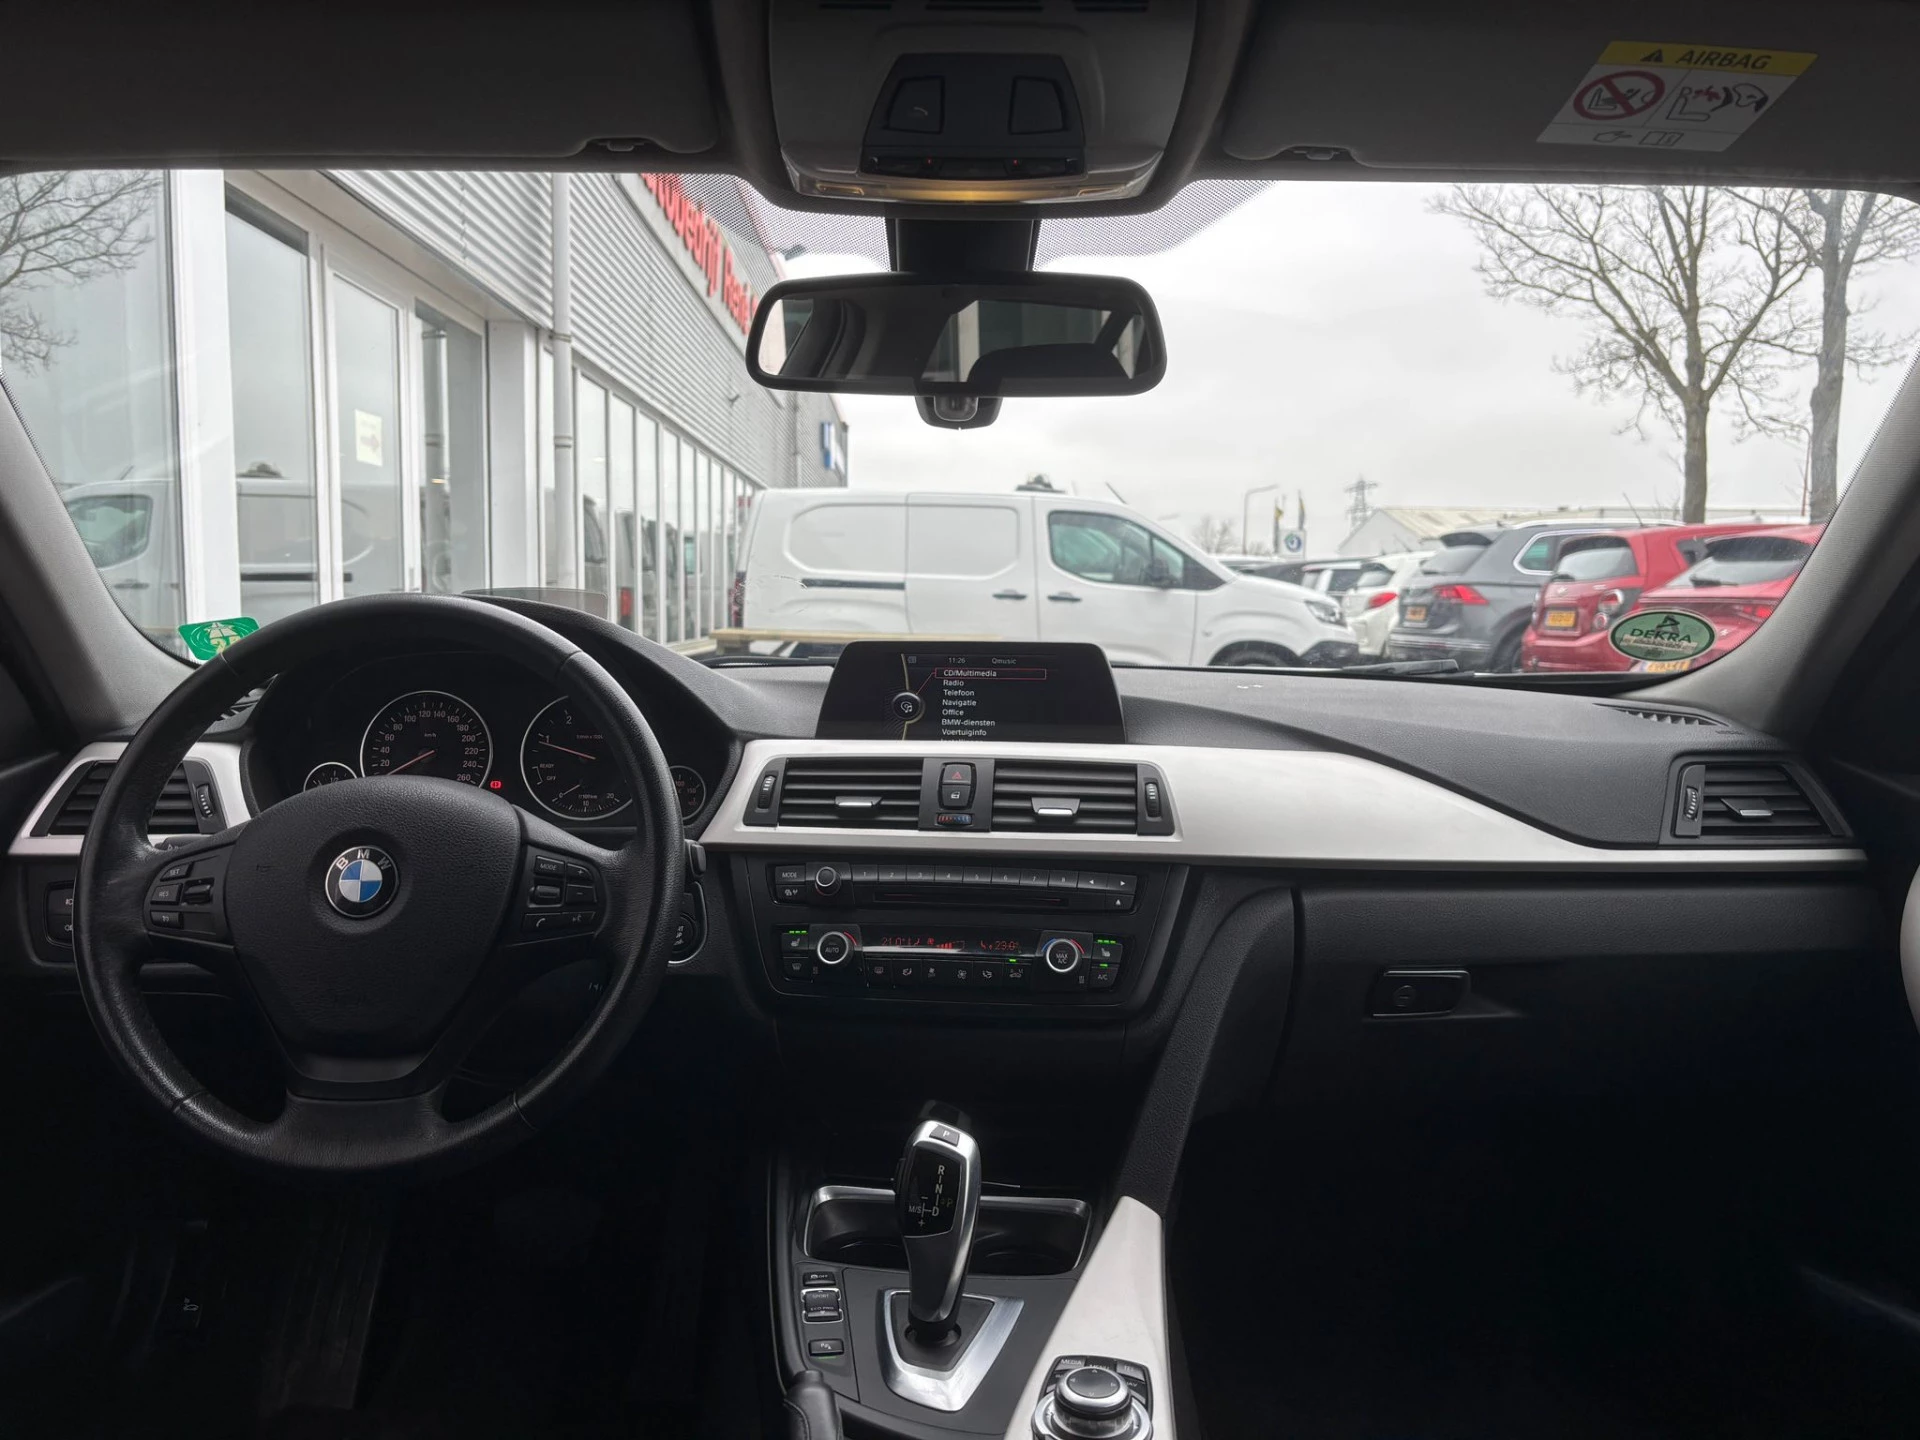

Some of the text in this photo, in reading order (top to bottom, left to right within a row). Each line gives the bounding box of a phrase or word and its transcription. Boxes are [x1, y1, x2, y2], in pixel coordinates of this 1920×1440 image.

[1675, 49, 1772, 69] AIRBAG
[1630, 628, 1692, 643] DEKRA
[991, 657, 1017, 665] Qmusic
[943, 679, 965, 687] Radio
[942, 699, 977, 708] Navigatie
[419, 710, 431, 718] 120
[434, 710, 446, 718] 140
[404, 715, 416, 723] 100
[565, 715, 573, 725] 2
[941, 718, 996, 726] BMW-diensten
[457, 724, 469, 732] 180
[942, 728, 987, 737] Voertuiginfo
[462, 734, 476, 742] 200
[380, 759, 390, 767] 20
[336, 849, 391, 870] BMW
[540, 863, 557, 871] MODE
[937, 1165, 945, 1175] R
[935, 1184, 943, 1194] N
[908, 1205, 921, 1214] M/S
[932, 1206, 939, 1216] D
